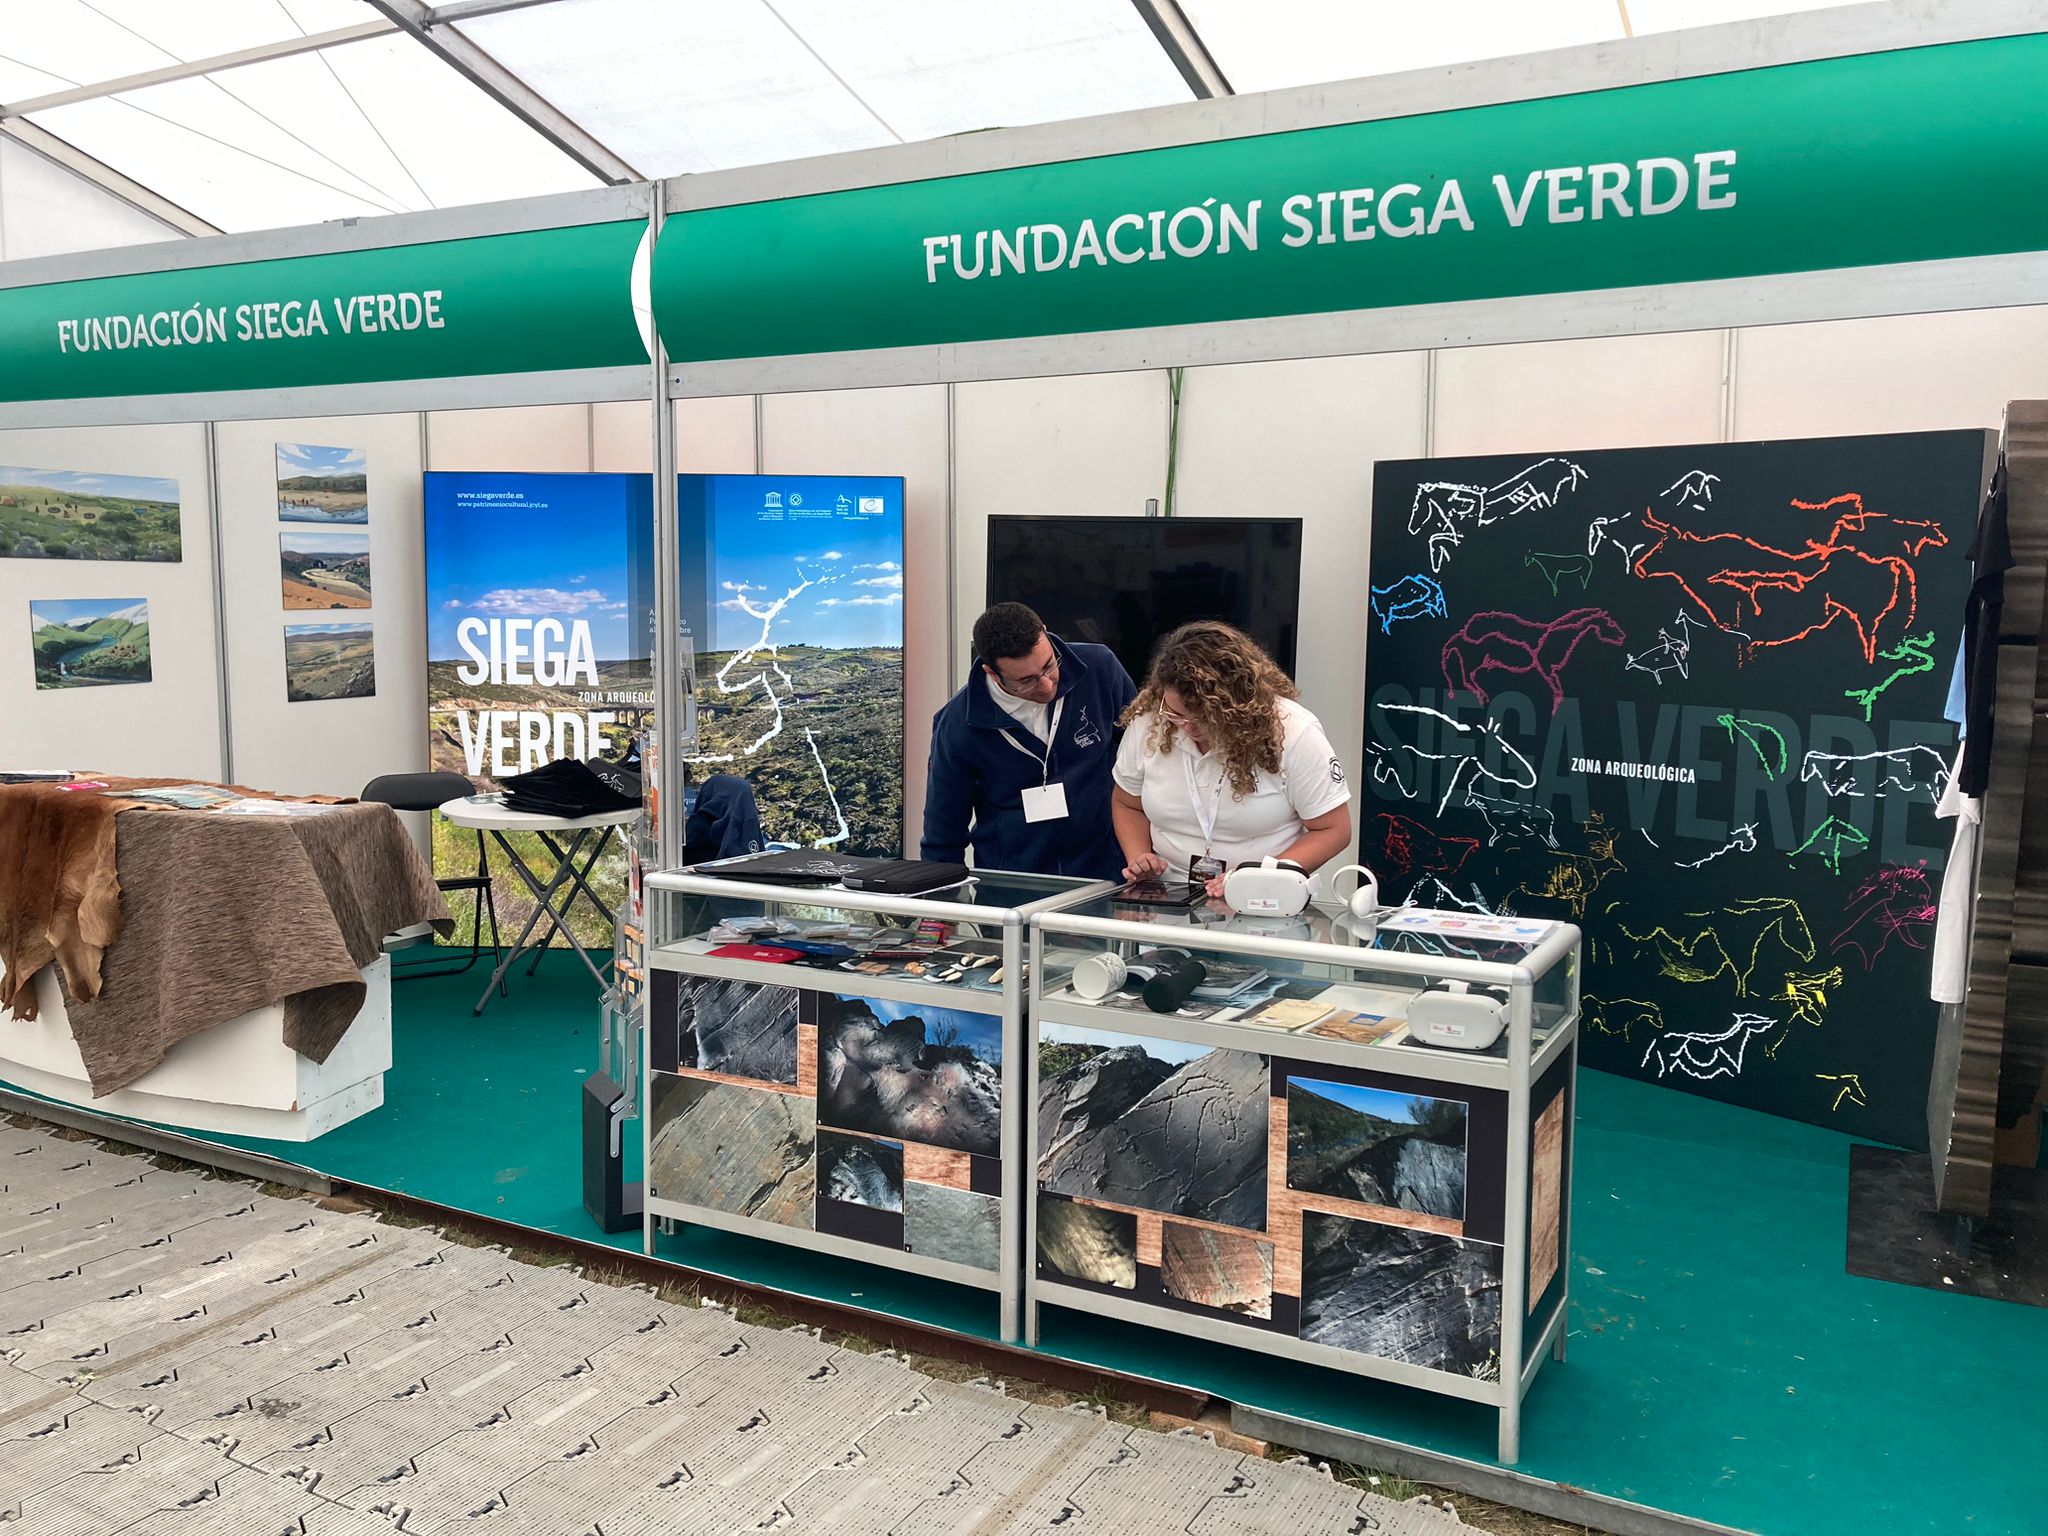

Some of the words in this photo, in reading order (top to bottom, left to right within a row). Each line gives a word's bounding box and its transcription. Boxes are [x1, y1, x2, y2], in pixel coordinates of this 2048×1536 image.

[923, 196, 1263, 284] FUNDACIÓN
[1281, 178, 1475, 249] SIEGA
[1492, 149, 1738, 228] VERDE
[57, 302, 228, 354] FUNDACIÓN
[235, 299, 329, 341] SIEGA
[333, 290, 446, 334] VERDE
[456, 491, 525, 501] www.siegaverde.es
[456, 616, 600, 687] SIEGA
[578, 691, 604, 703] ZONA
[456, 709, 615, 777] VERDE
[1571, 757, 1602, 774] ZONA
[1604, 760, 1696, 784] ARQUEOLÓGICA
[1366, 681, 1590, 826] SIEGA
[1616, 699, 1960, 872] VERDE
